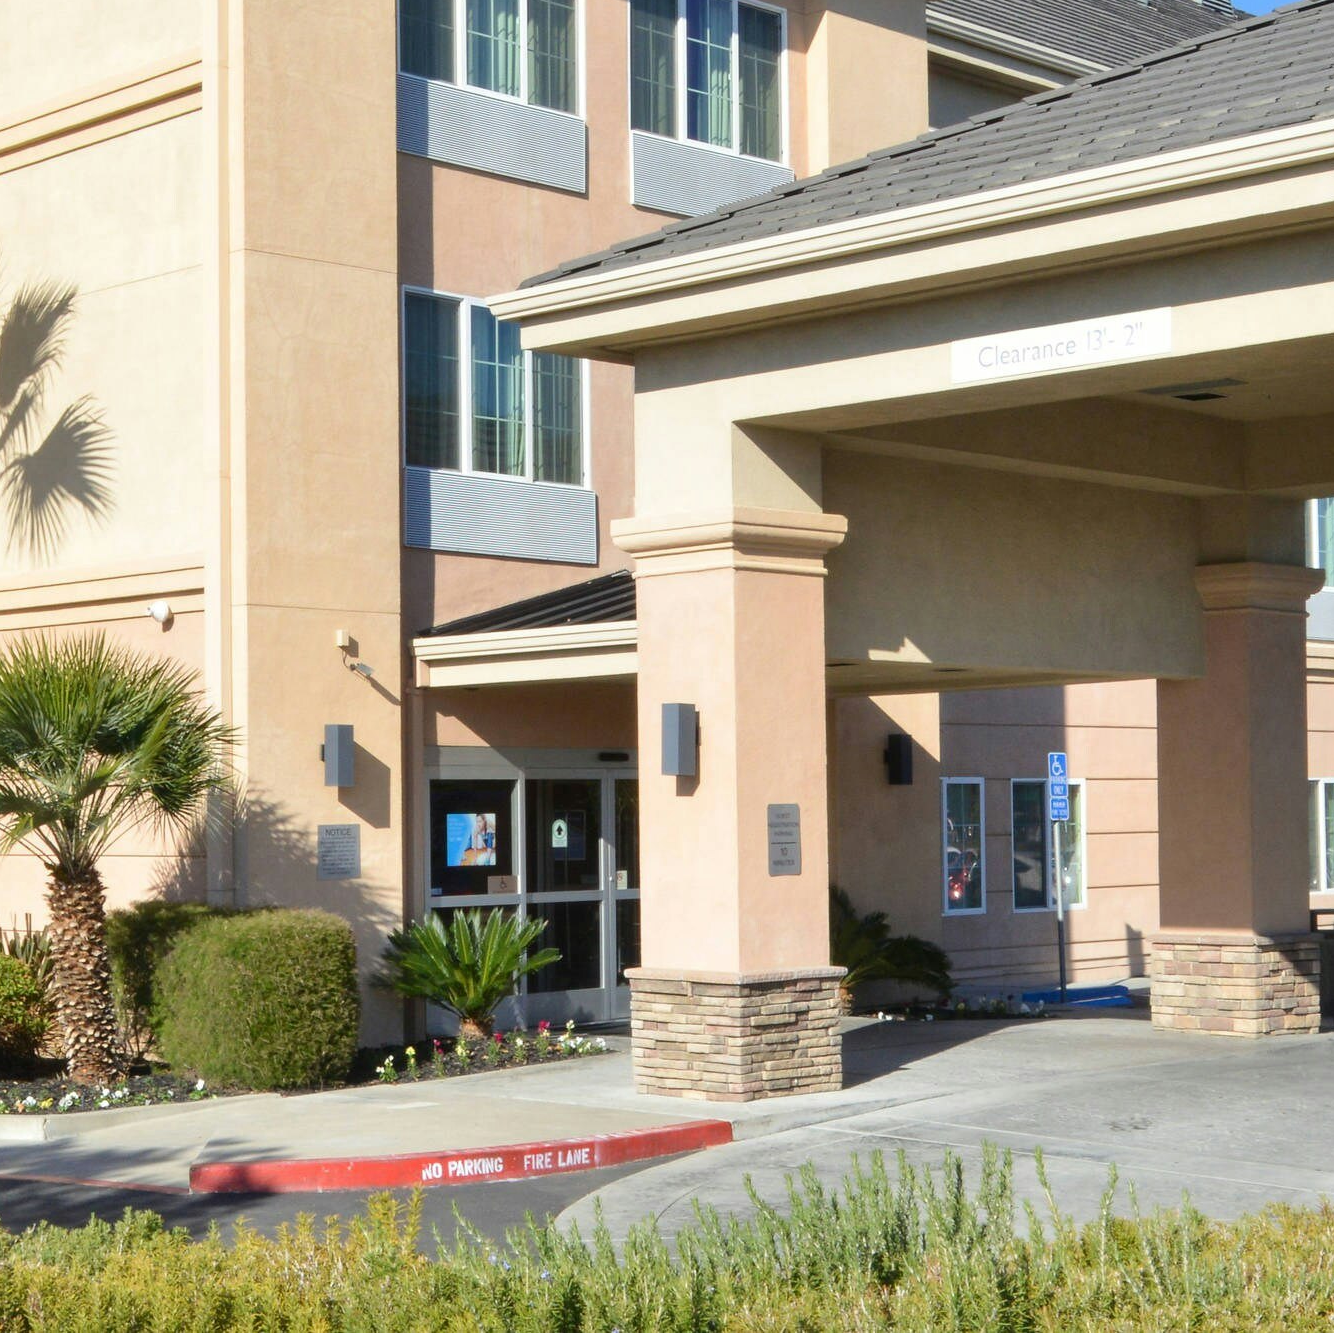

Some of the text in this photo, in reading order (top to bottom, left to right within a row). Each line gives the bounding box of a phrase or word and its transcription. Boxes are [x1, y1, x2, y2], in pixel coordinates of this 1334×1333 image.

[978, 339, 1077, 368] Clearance
[323, 828, 352, 836] NOTICE
[422, 1156, 503, 1180] NO PARKING
[523, 1148, 590, 1170] FIRE LANE
